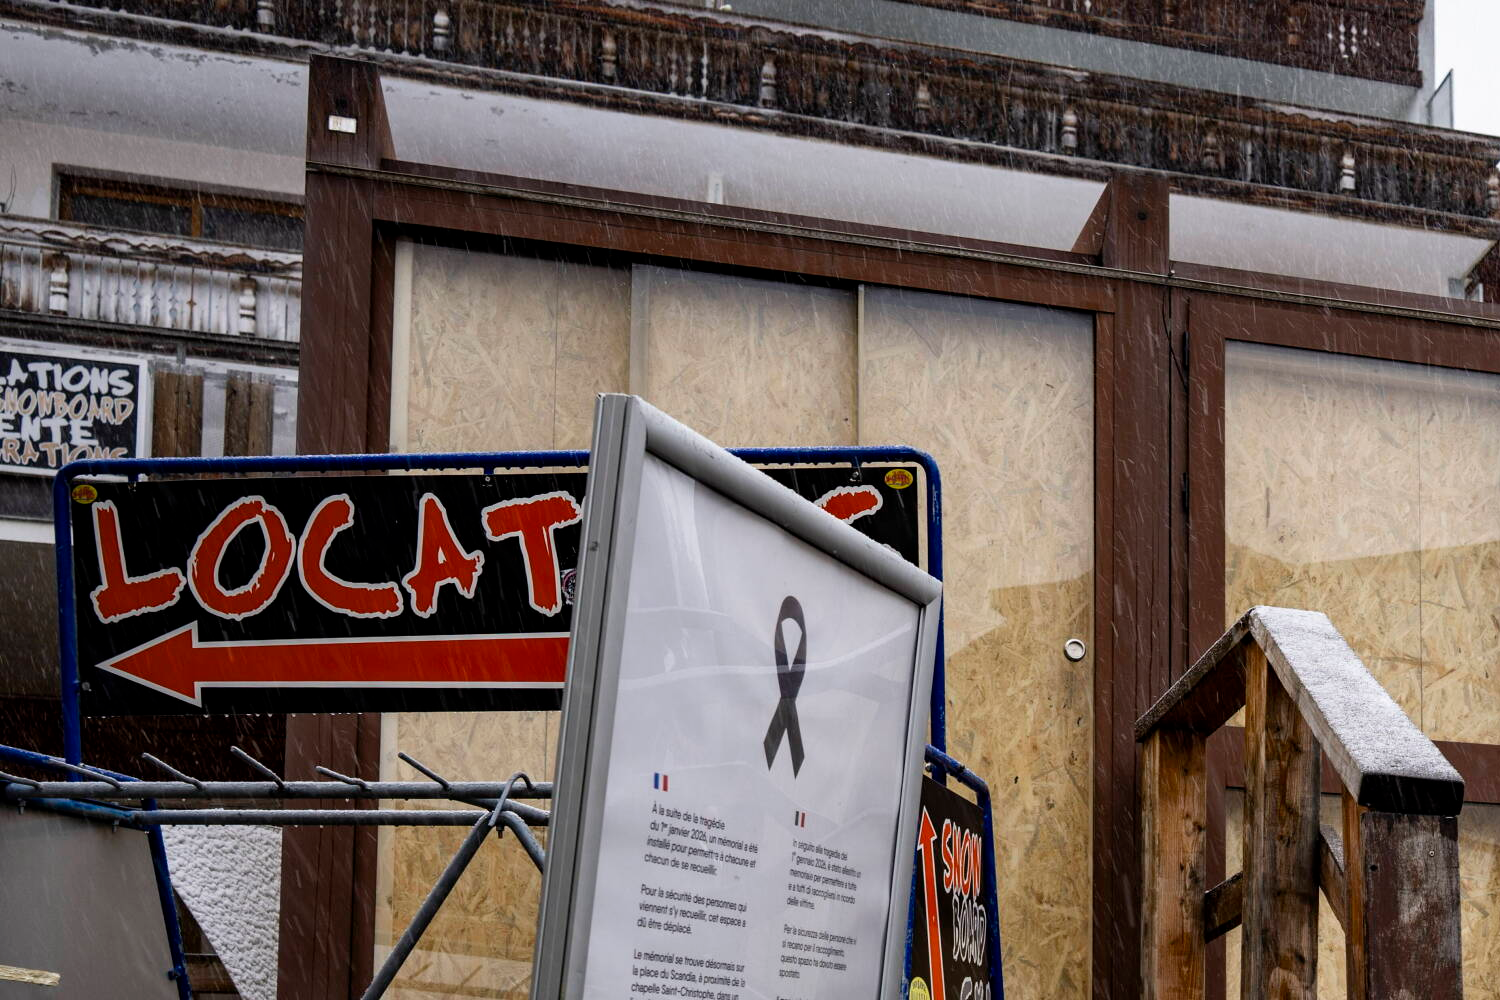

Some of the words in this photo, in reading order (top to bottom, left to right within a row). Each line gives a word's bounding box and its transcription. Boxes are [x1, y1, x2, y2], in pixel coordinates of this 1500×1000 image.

[0, 358, 134, 397] ATIONS
[0, 387, 135, 425] NOWBOARD
[942, 818, 982, 901] SNOW
[952, 892, 987, 967] BOARD
